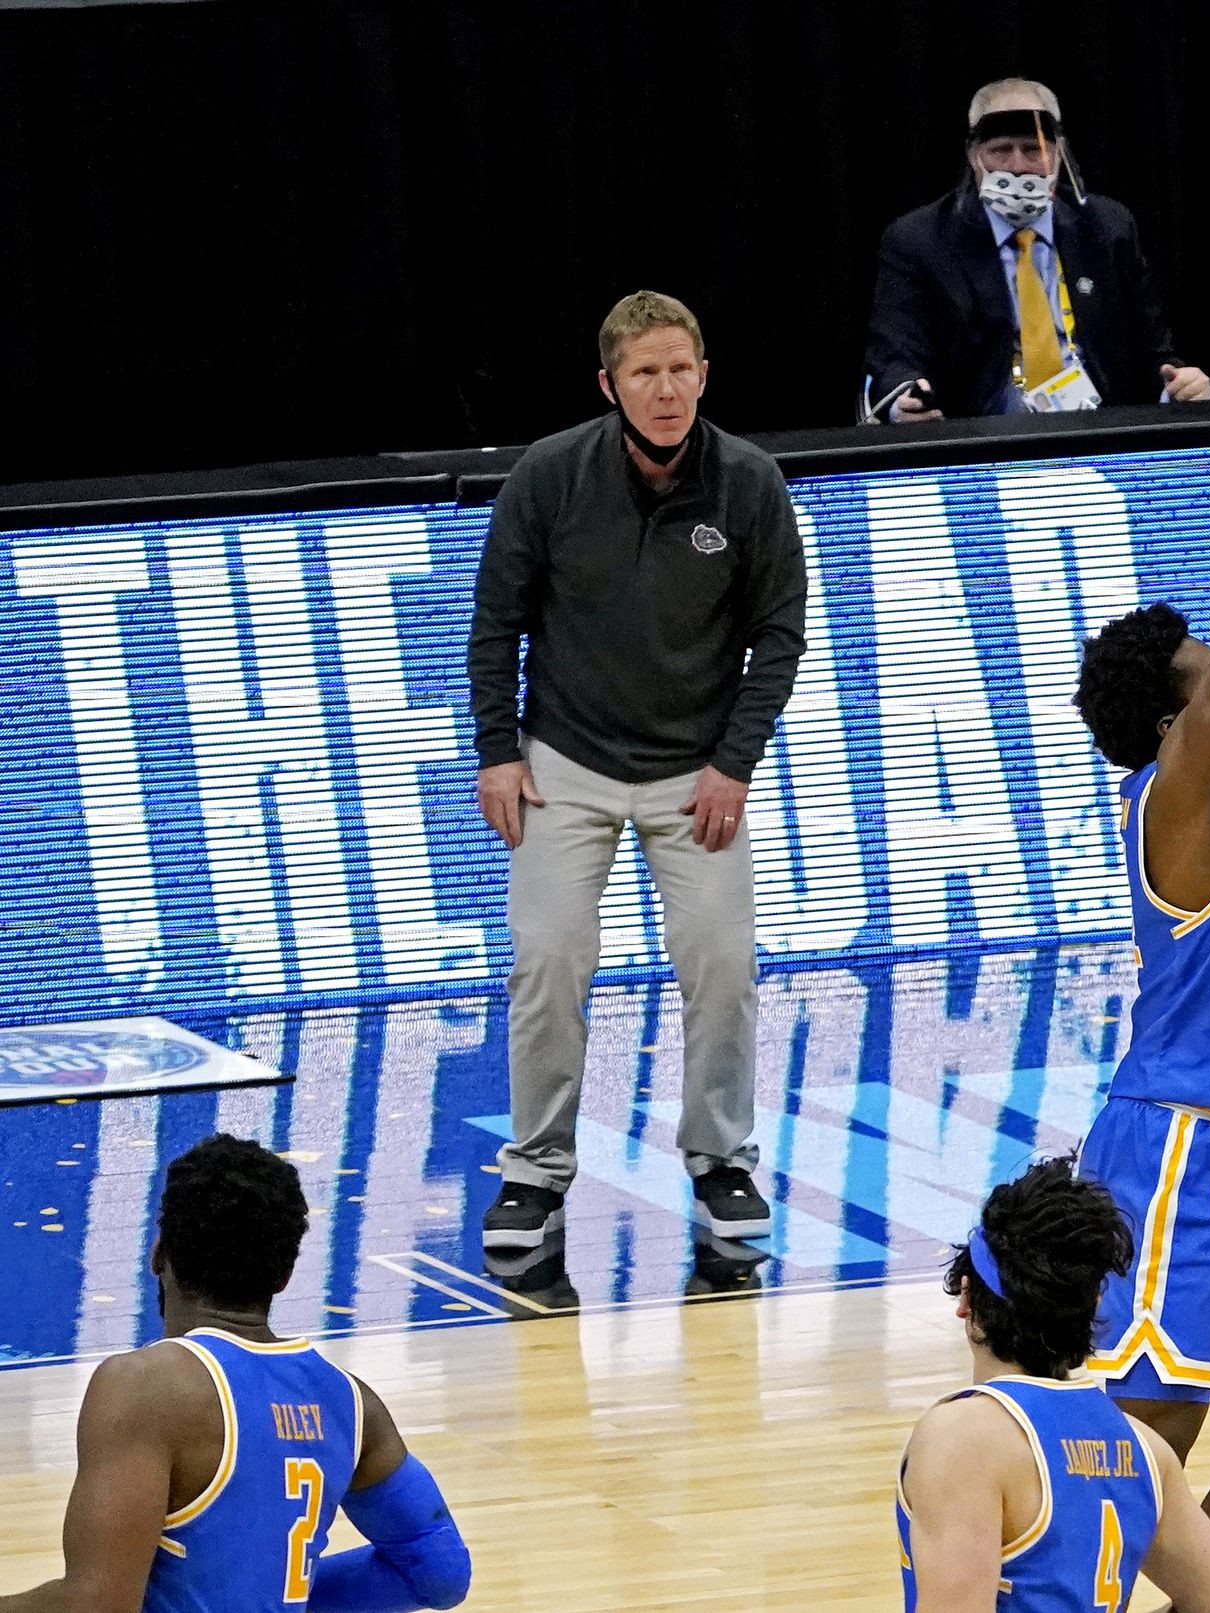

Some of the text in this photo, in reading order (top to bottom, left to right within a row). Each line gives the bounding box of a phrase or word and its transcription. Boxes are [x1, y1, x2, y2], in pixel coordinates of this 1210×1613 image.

[9, 512, 491, 1001] THE
[270, 1402, 324, 1441] RILEY
[1060, 1439, 1139, 1480] JAQUEZ JR.
[283, 1457, 325, 1604] 2
[1094, 1499, 1124, 1613] 4
